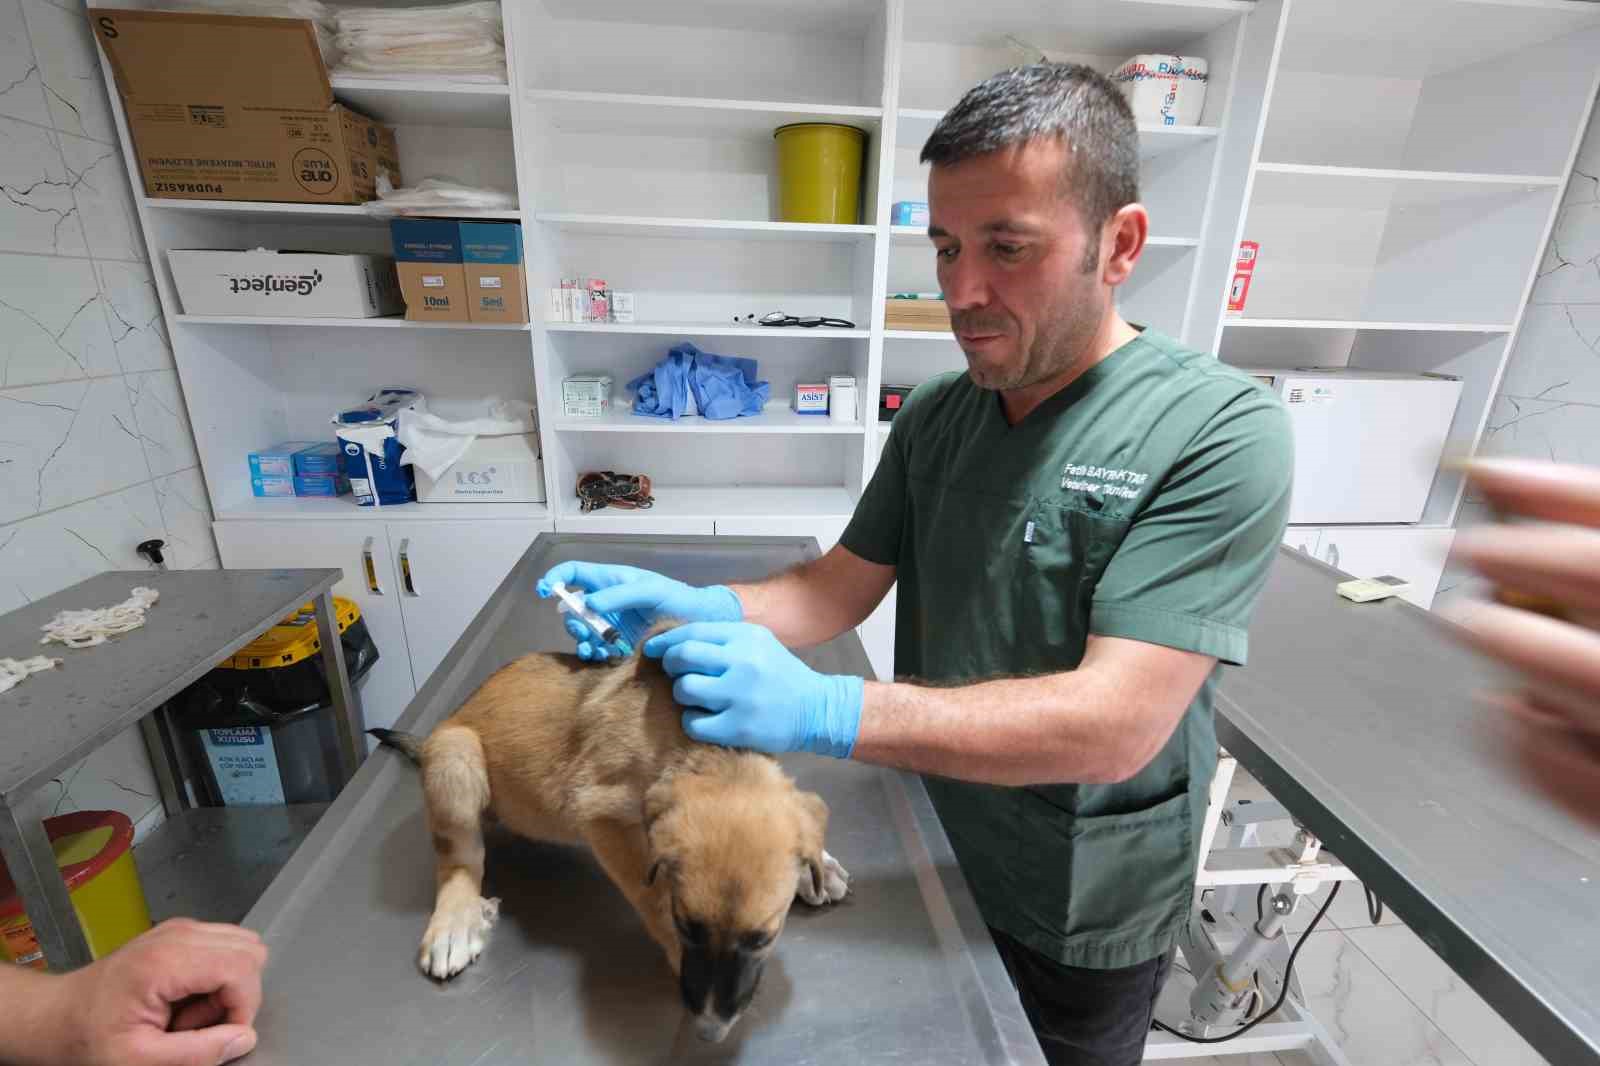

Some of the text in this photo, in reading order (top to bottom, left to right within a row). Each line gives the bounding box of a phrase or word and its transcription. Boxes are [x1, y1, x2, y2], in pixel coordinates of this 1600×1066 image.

[99, 16, 119, 39] S
[301, 170, 332, 182] one
[155, 183, 224, 193] PUDRASIZ
[229, 275, 314, 297] Genject
